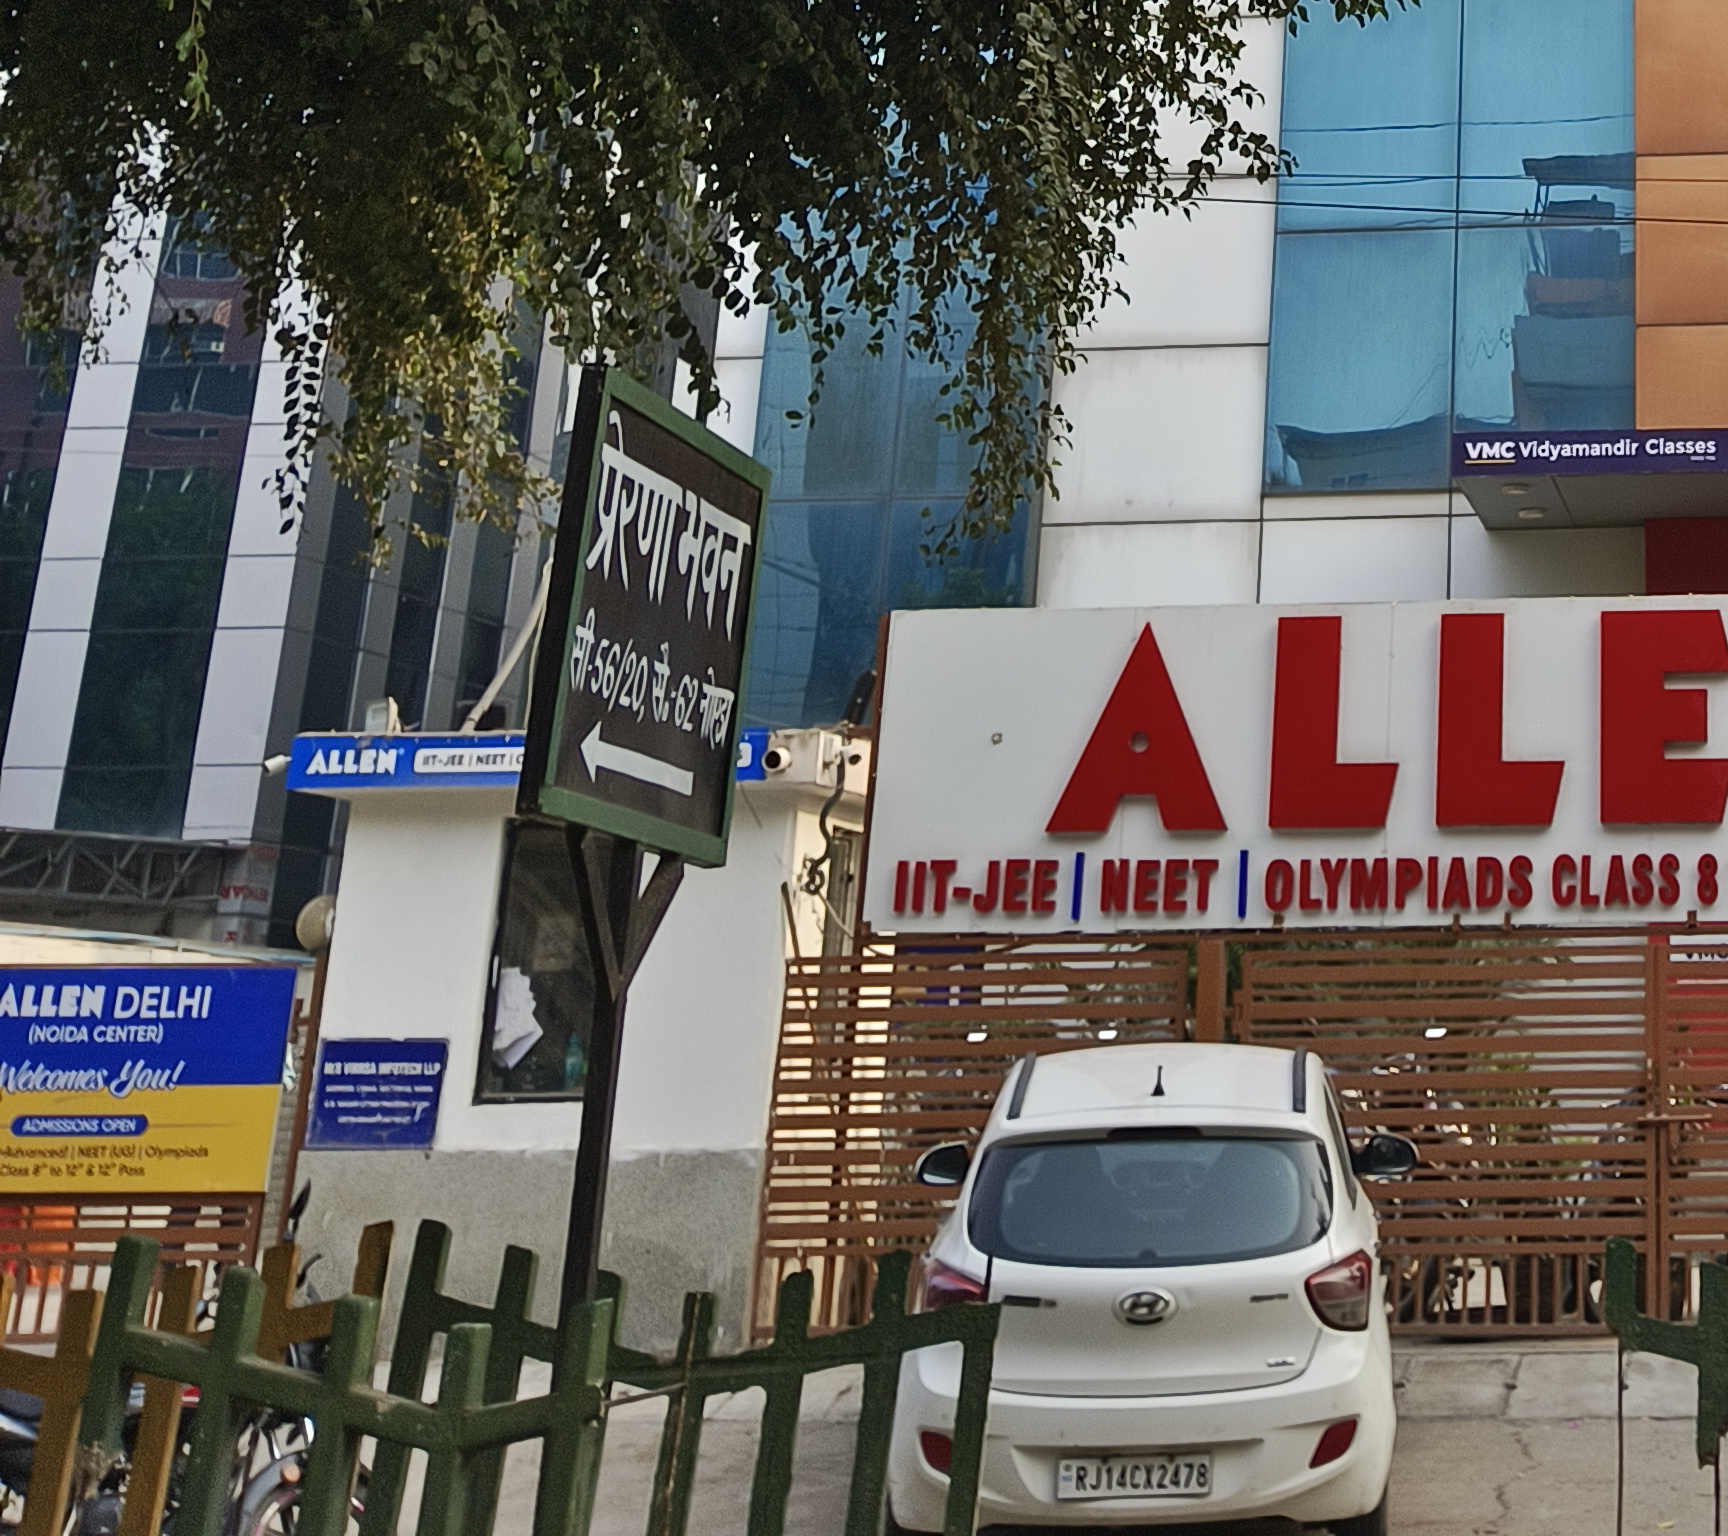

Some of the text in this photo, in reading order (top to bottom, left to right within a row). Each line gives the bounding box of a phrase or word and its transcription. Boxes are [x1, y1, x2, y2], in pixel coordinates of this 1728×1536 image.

[1466, 438, 1716, 460] VMC Vidyamandir Classes
[586, 410, 751, 642] प्रेरणा भवन
[306, 748, 397, 775] ALLEN
[893, 859, 1059, 913] IIT-JEE
[1101, 858, 1219, 912] NEET
[1264, 854, 1533, 912] OLYMPIADS
[1551, 853, 1680, 907] CLASS
[1697, 853, 1719, 906] 8
[0, 983, 212, 1019] ALLEN DELHI
[28, 1023, 164, 1045] (NOIDA CENTER)
[109, 1059, 186, 1099] You!
[101, 1118, 136, 1133] OPEN
[1075, 1463, 1209, 1491] RJ14CX2478
